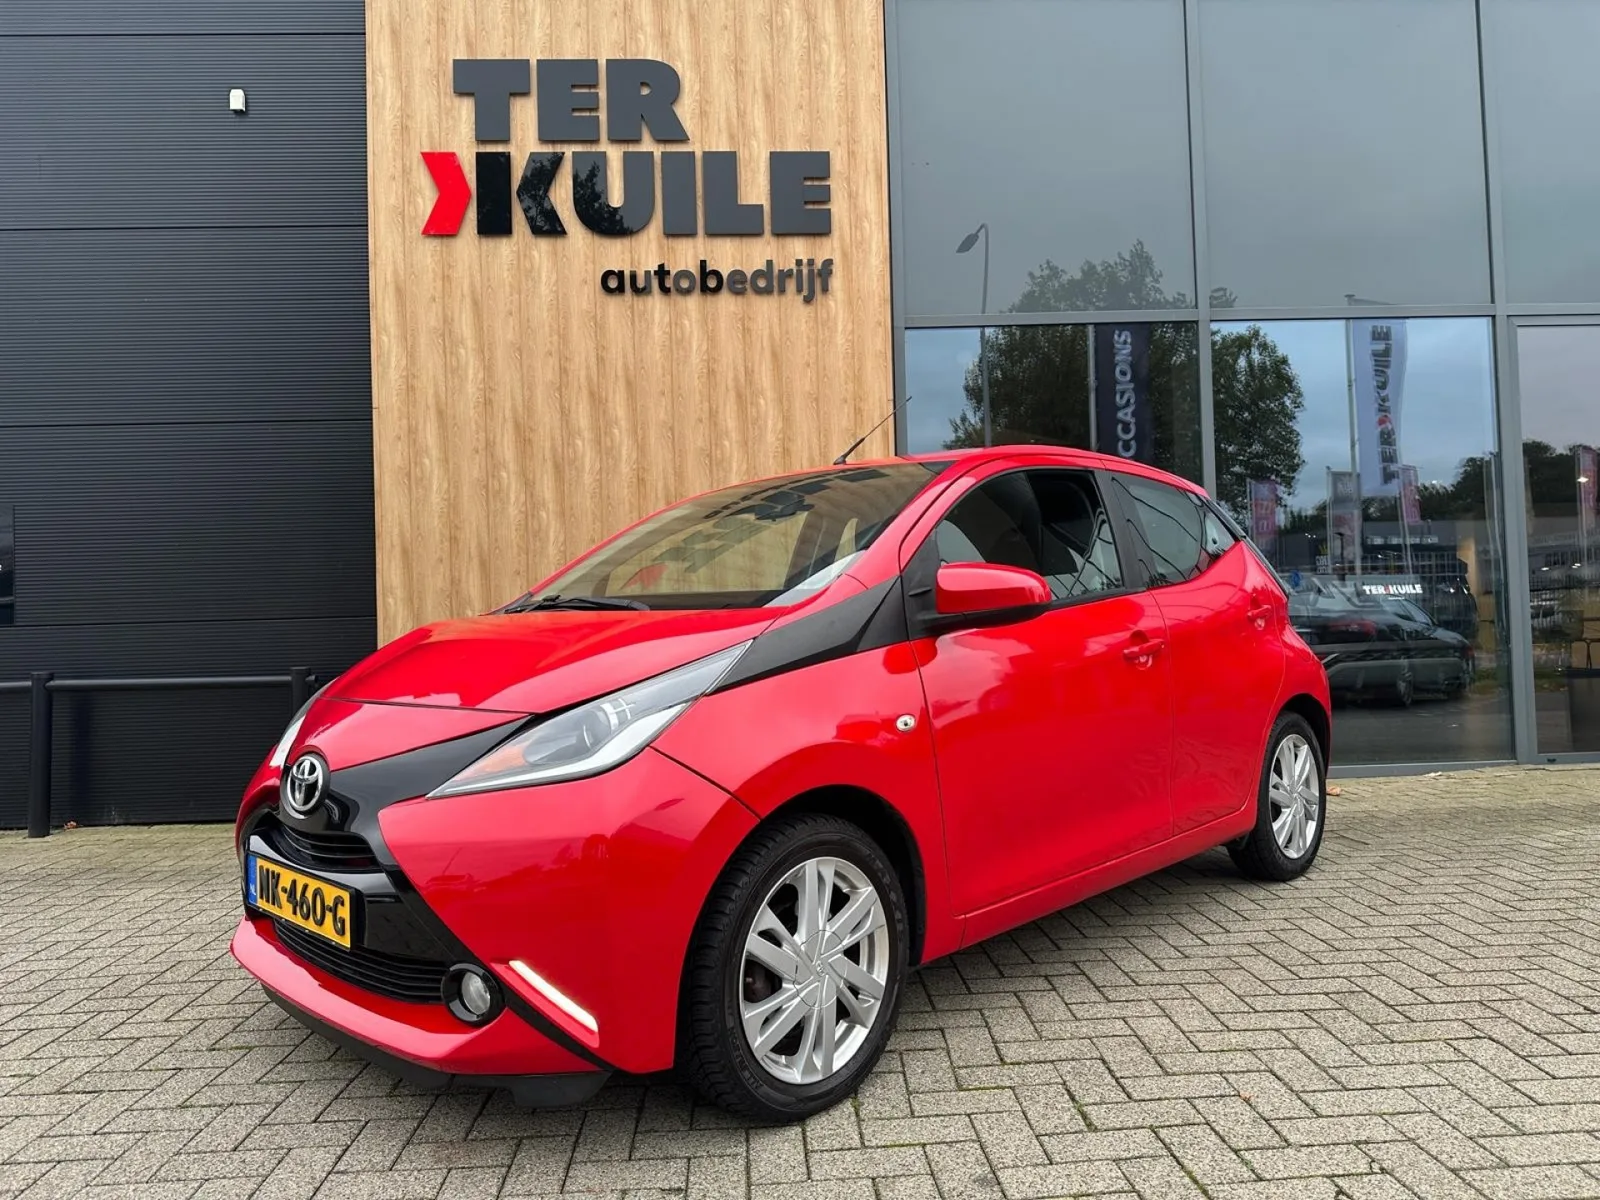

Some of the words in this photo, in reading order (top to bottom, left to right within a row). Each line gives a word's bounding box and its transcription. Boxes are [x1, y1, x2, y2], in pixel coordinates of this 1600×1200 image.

[453, 59, 690, 141] TER
[475, 151, 832, 236] KUILE
[600, 258, 833, 302] autobedrijf
[1113, 329, 1137, 457] CCASIONS
[1371, 325, 1392, 414] KUILE
[1379, 426, 1400, 485] TER
[1362, 584, 1386, 595] TER
[1388, 583, 1423, 595] KUILE
[258, 864, 346, 937] NK-460-G
